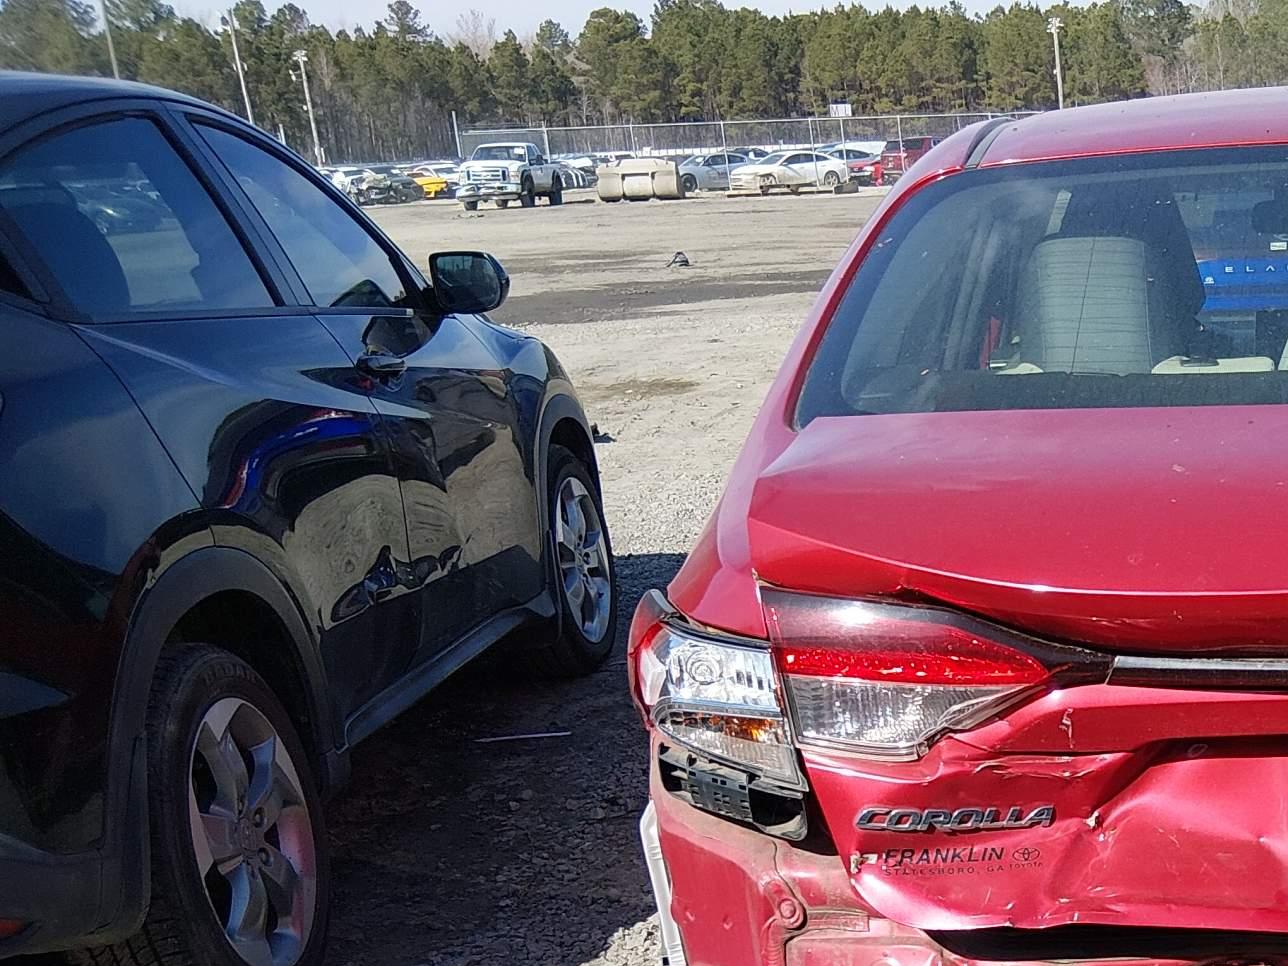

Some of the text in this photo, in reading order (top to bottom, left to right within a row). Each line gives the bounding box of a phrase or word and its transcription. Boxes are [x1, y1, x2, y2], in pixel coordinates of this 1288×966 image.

[856, 804, 1056, 832] COROLLA
[884, 847, 1005, 867] FRANKLIN
[988, 865, 1005, 873] GA
[1009, 862, 1043, 870] TOYOTA
